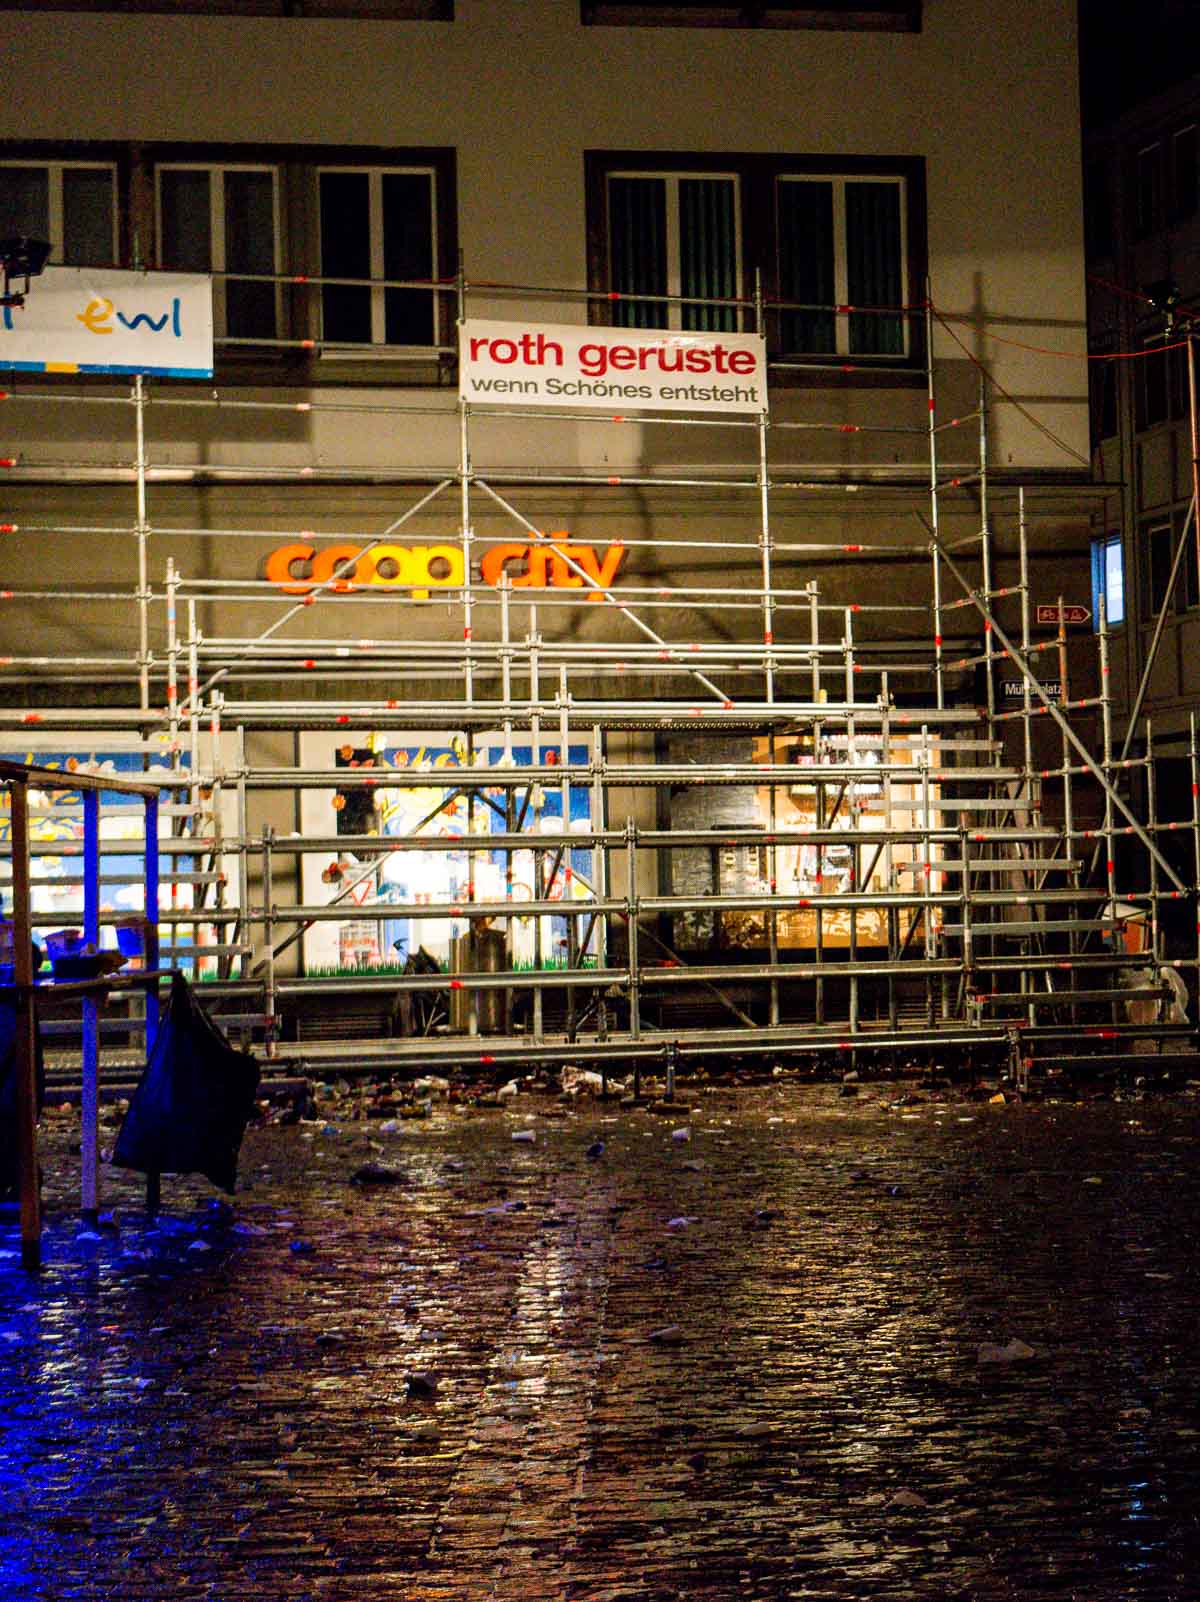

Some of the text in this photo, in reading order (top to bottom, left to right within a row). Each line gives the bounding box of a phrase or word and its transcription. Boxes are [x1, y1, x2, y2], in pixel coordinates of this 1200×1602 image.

[76, 297, 182, 337] ewl
[469, 333, 757, 377] roth gerüste
[471, 378, 758, 403] wenn Schönes entsteht
[265, 530, 625, 602] coop city
